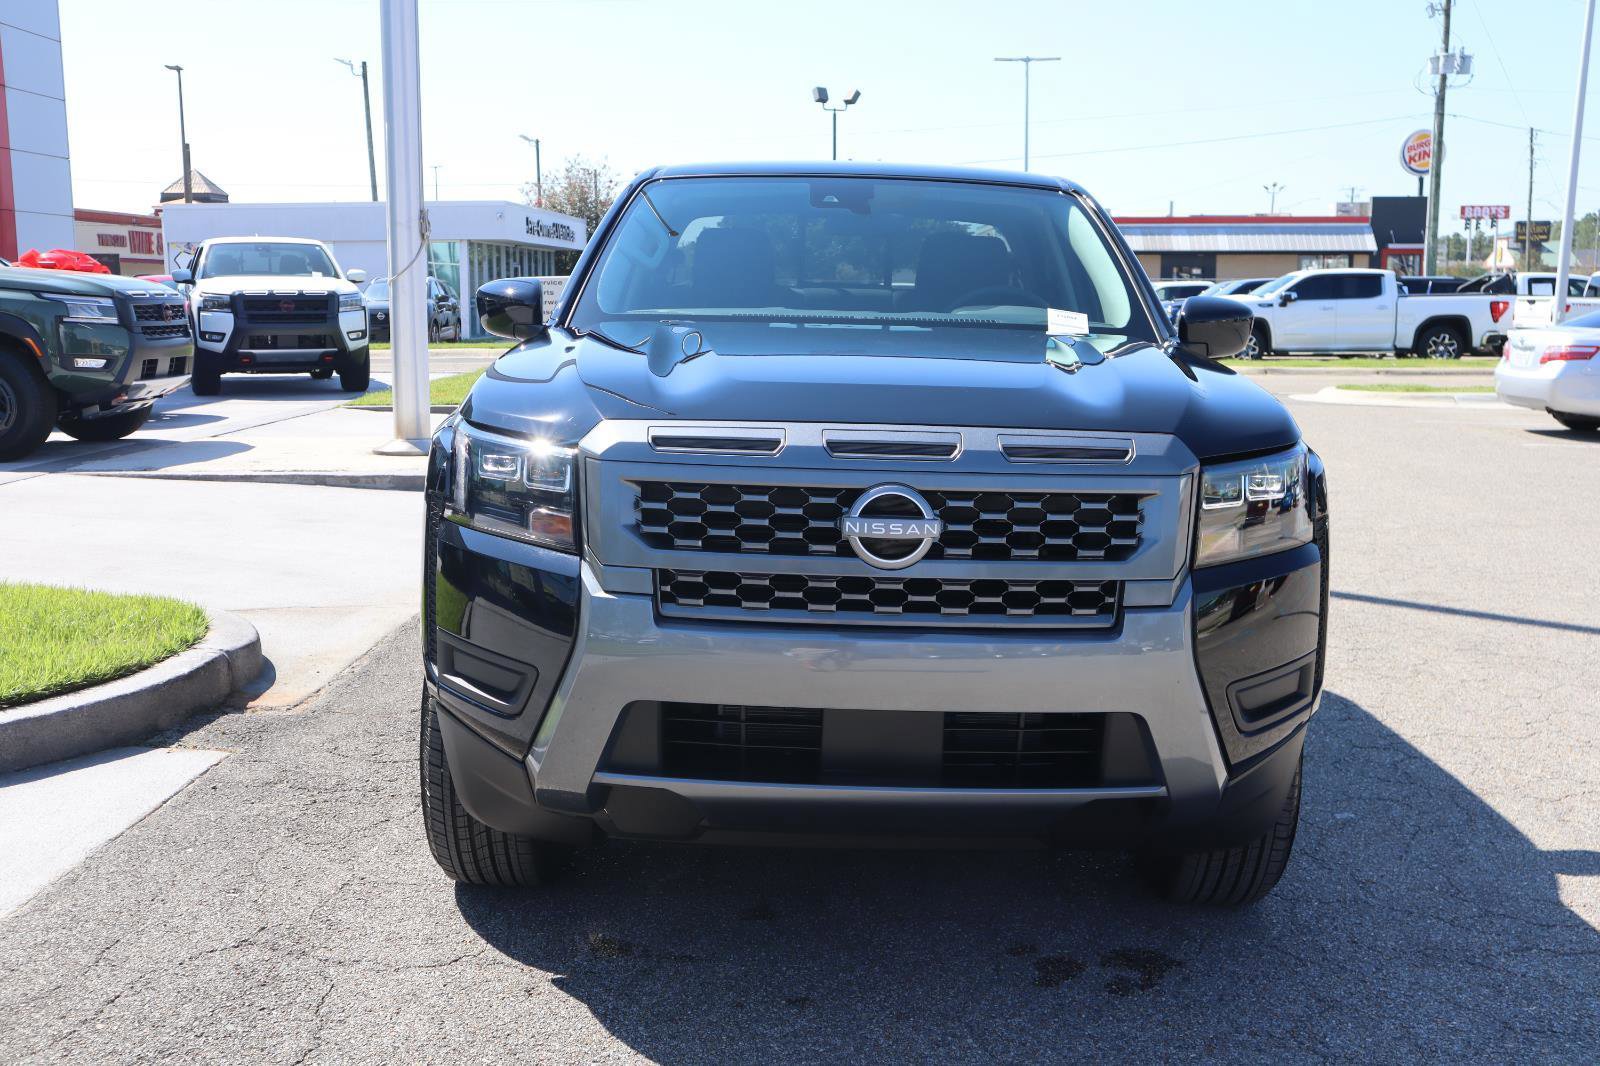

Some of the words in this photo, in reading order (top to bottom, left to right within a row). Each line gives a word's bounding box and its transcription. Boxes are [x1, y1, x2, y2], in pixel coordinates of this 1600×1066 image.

[1407, 138, 1431, 153] BURG
[1408, 150, 1431, 164] KIN
[1465, 206, 1506, 219] BOOTS
[128, 230, 155, 254] WINE
[845, 521, 938, 535] NISSAN
